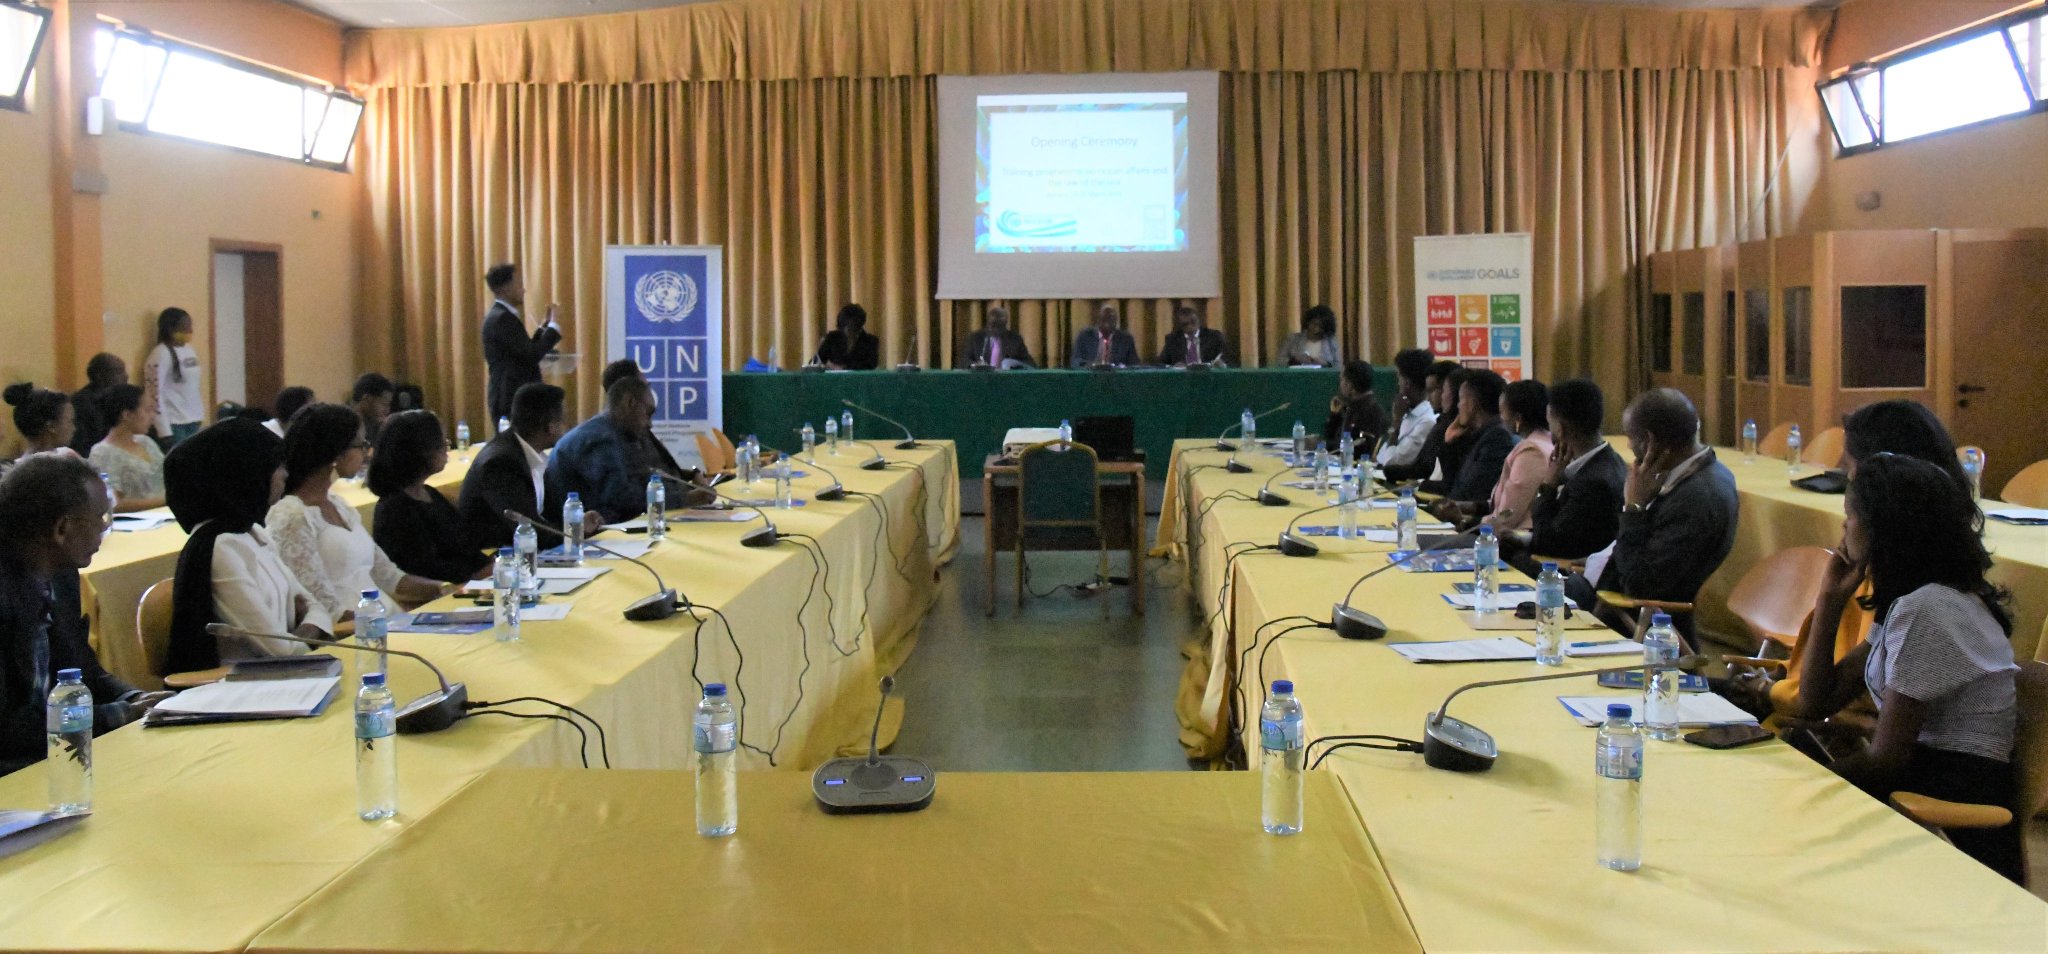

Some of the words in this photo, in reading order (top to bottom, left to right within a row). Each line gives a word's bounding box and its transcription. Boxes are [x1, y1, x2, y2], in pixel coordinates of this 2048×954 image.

[1031, 136, 1078, 149] Opening
[1081, 135, 1138, 148] Ceremony
[1477, 268, 1519, 280] GOALS
